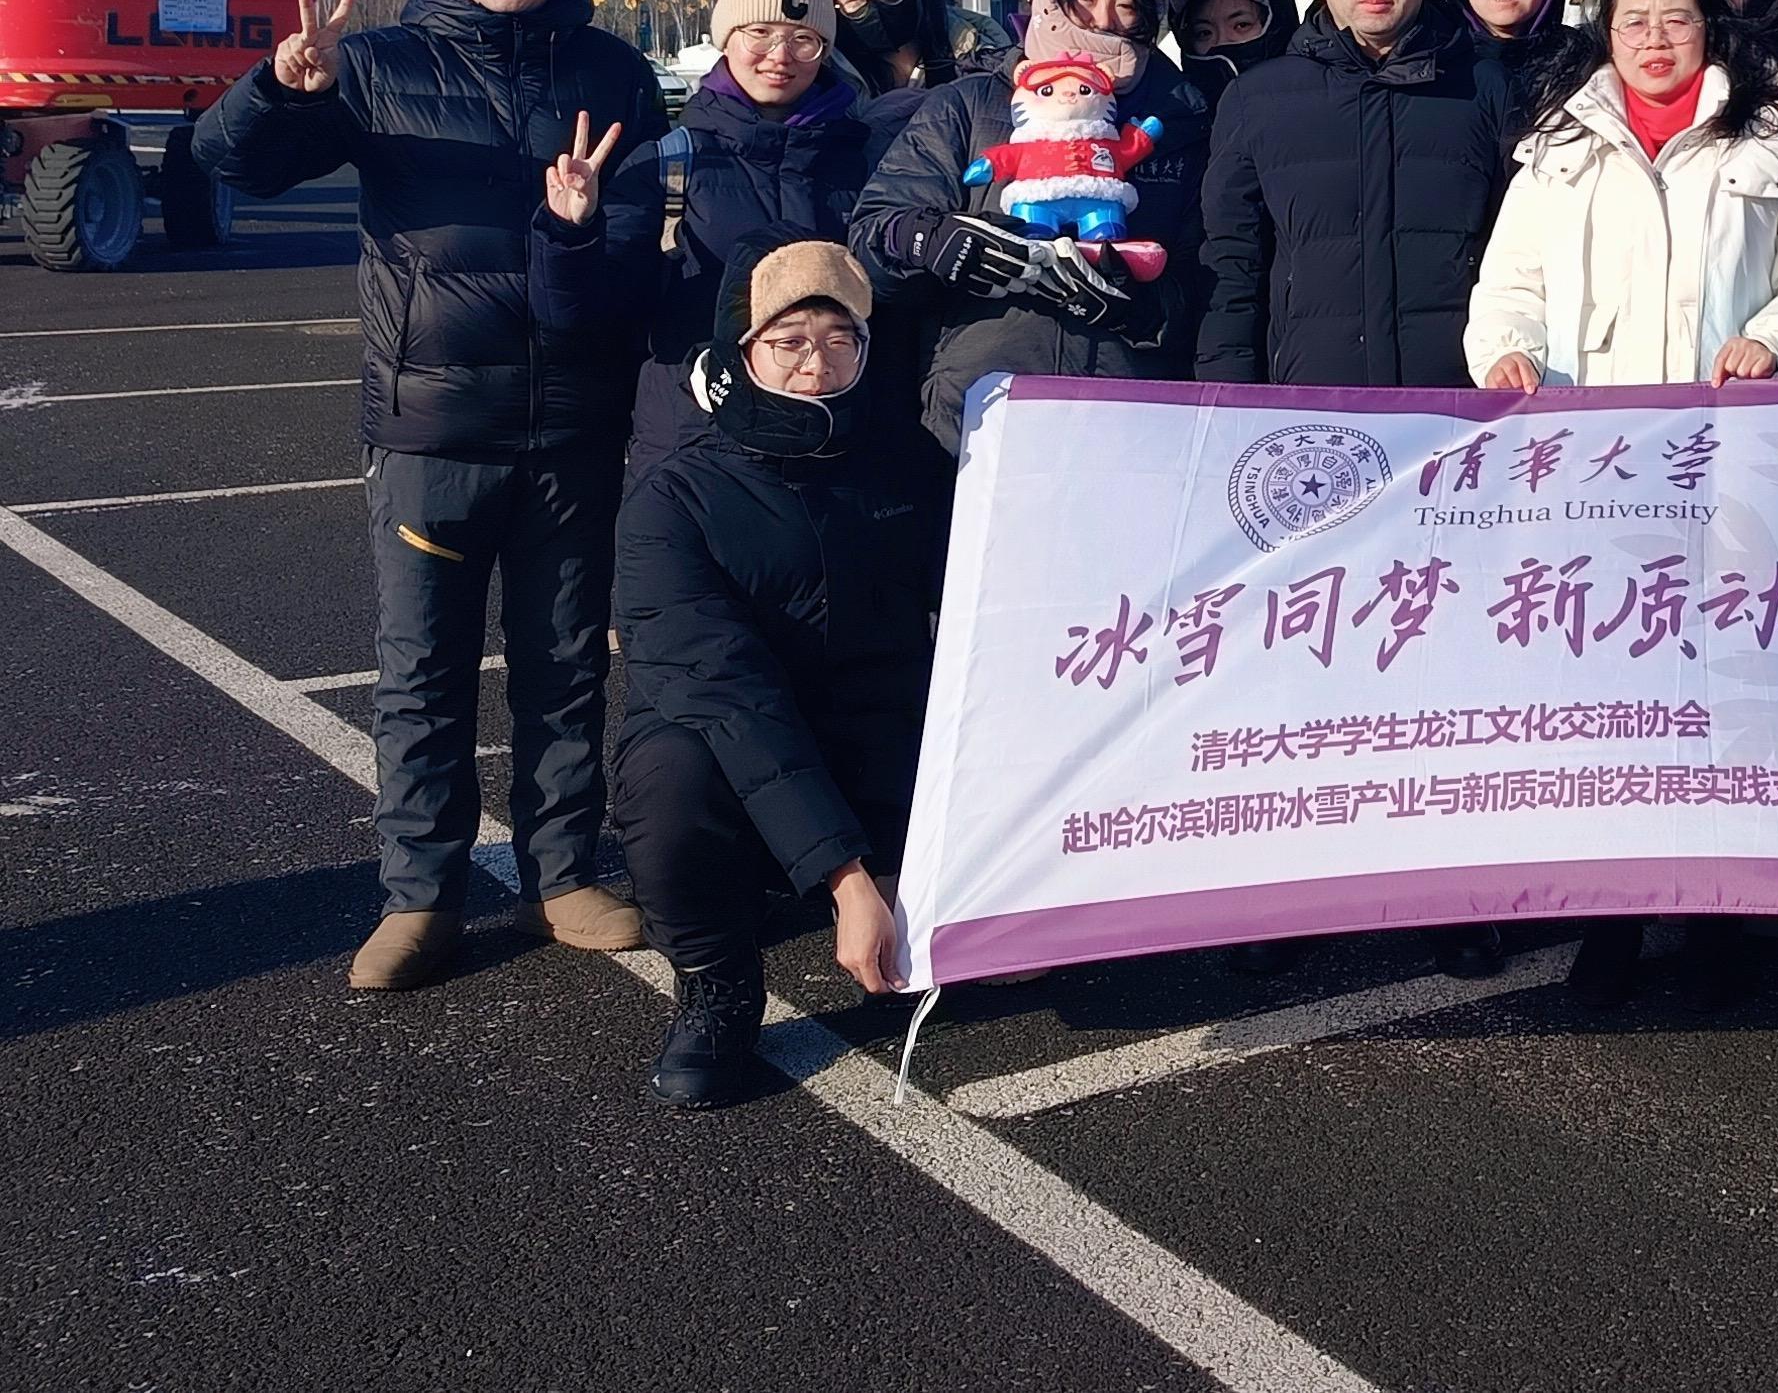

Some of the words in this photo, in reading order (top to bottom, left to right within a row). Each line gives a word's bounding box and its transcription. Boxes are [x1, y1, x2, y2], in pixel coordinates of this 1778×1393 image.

[1244, 465, 1272, 529] TSINGHUA
[1414, 504, 1552, 530] Tsinghua
[1564, 498, 1719, 525] University
[1055, 556, 1461, 690] 冰雪同梦
[1191, 699, 1711, 772] 清华大学学生龙江文化交流协会
